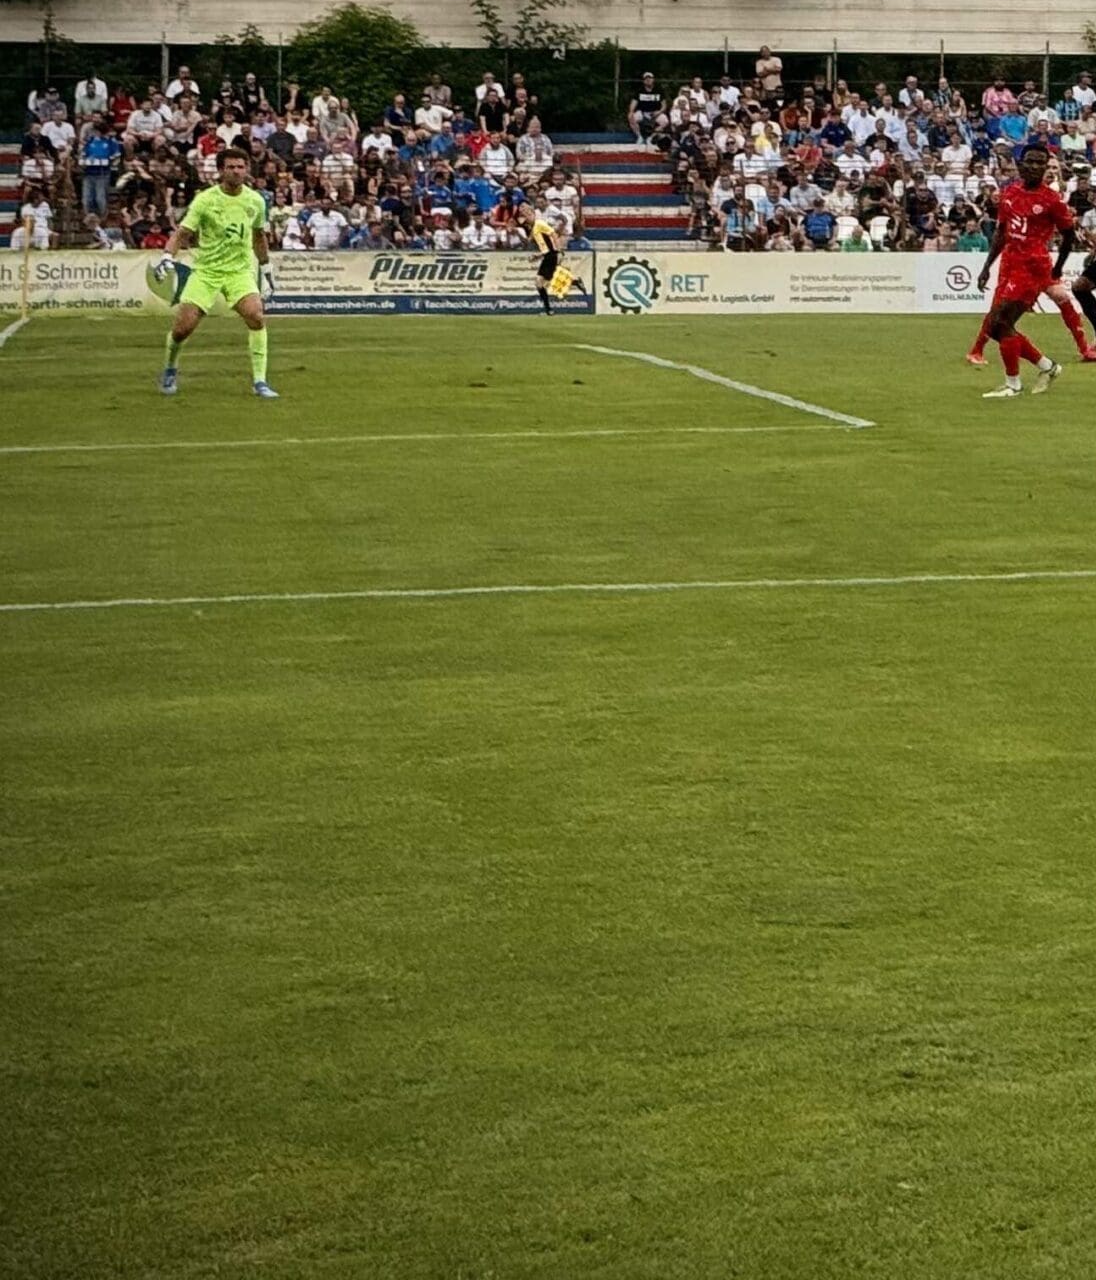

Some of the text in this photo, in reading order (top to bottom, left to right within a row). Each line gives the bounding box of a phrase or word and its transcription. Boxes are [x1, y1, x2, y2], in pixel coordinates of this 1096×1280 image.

[36, 263, 119, 280] Schmidt
[369, 258, 488, 280] PlanTec
[671, 275, 709, 293] RET
